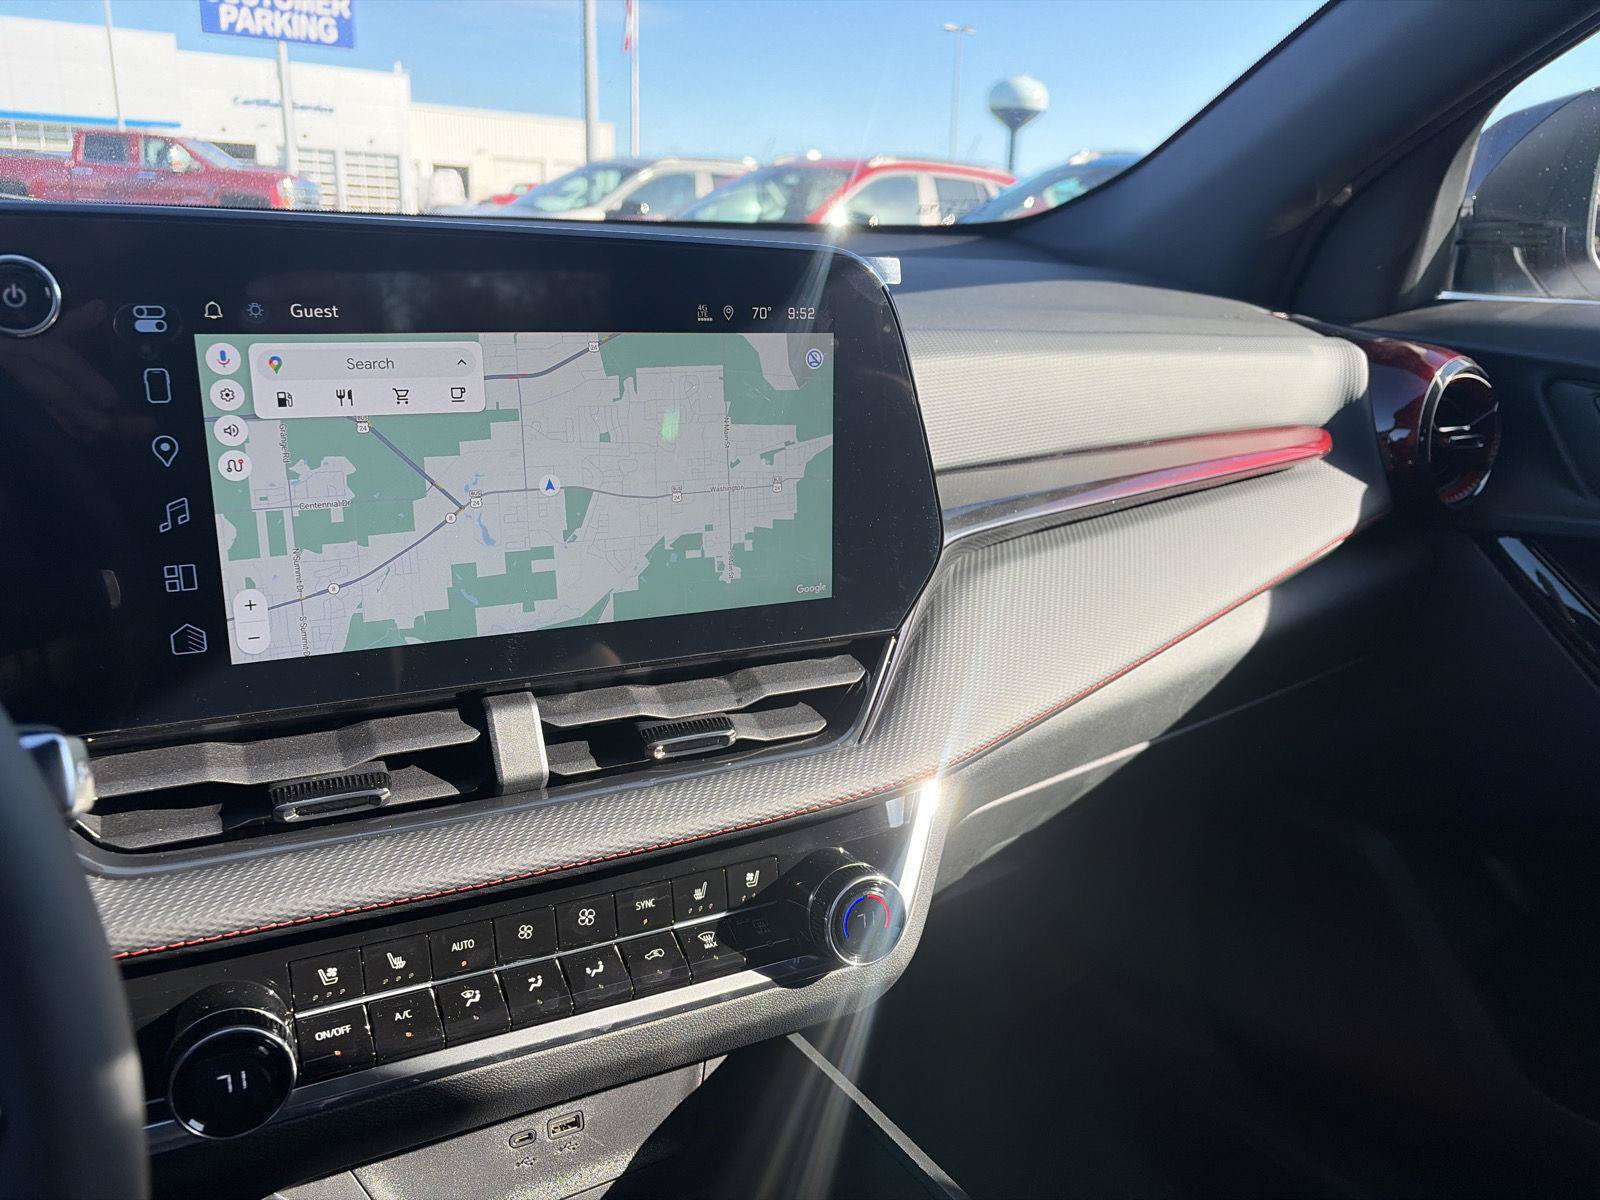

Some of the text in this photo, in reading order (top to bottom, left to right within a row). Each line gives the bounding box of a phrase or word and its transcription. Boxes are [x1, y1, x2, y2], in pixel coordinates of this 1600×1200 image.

[218, 3, 339, 44] PARKING
[290, 303, 339, 319] Guest
[751, 306, 772, 320] 70°
[787, 307, 815, 320] 9:52
[346, 357, 395, 371] Search
[282, 452, 290, 464] Rd
[710, 484, 745, 493] Washington
[299, 499, 352, 510] Centennial Dr
[796, 582, 827, 594] Google
[635, 898, 656, 911] SYNC
[451, 938, 475, 953] AUTO
[703, 939, 718, 949] MAX
[394, 1008, 413, 1022] A/C
[314, 1024, 353, 1042] ON/OFF
